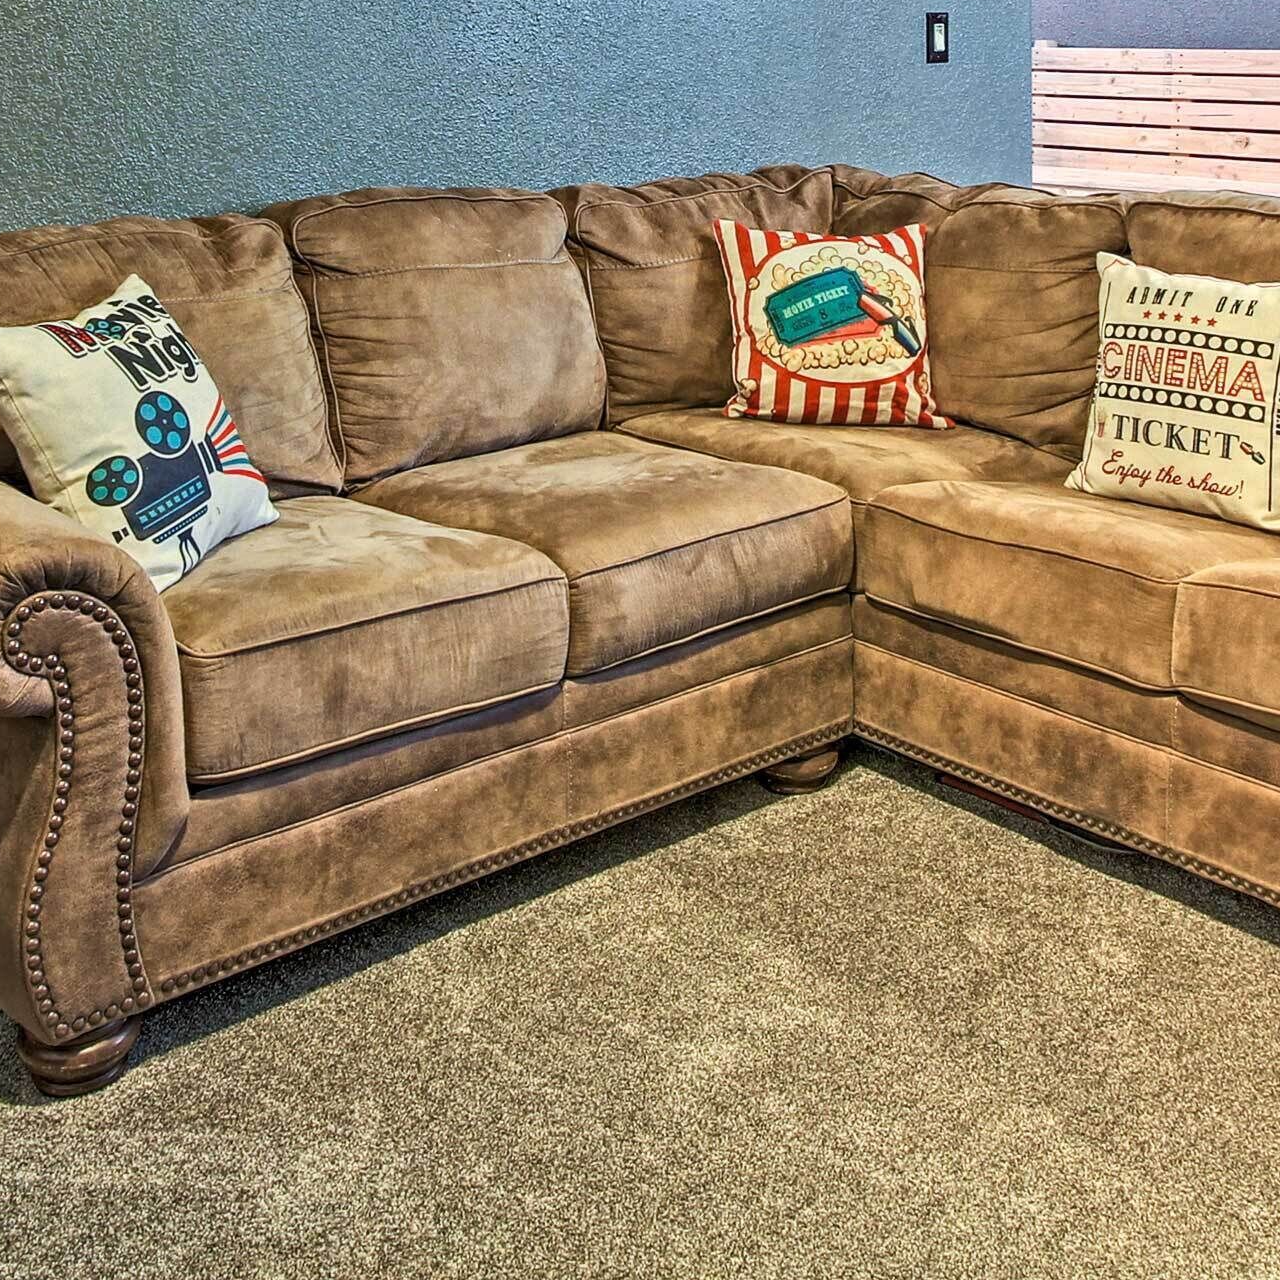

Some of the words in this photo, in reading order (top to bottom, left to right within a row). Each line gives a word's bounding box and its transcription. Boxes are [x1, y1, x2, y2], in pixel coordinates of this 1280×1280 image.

[782, 297, 815, 319] MOVIE
[814, 285, 850, 305] TICKET
[1126, 286, 1193, 307] ADMIT
[1215, 296, 1259, 318] ONE
[1100, 340, 1266, 402] CINEMA
[1111, 413, 1241, 461] TICKET
[1101, 449, 1152, 488] Enjoy
[1156, 465, 1184, 487] the
[1186, 472, 1246, 500] show!
